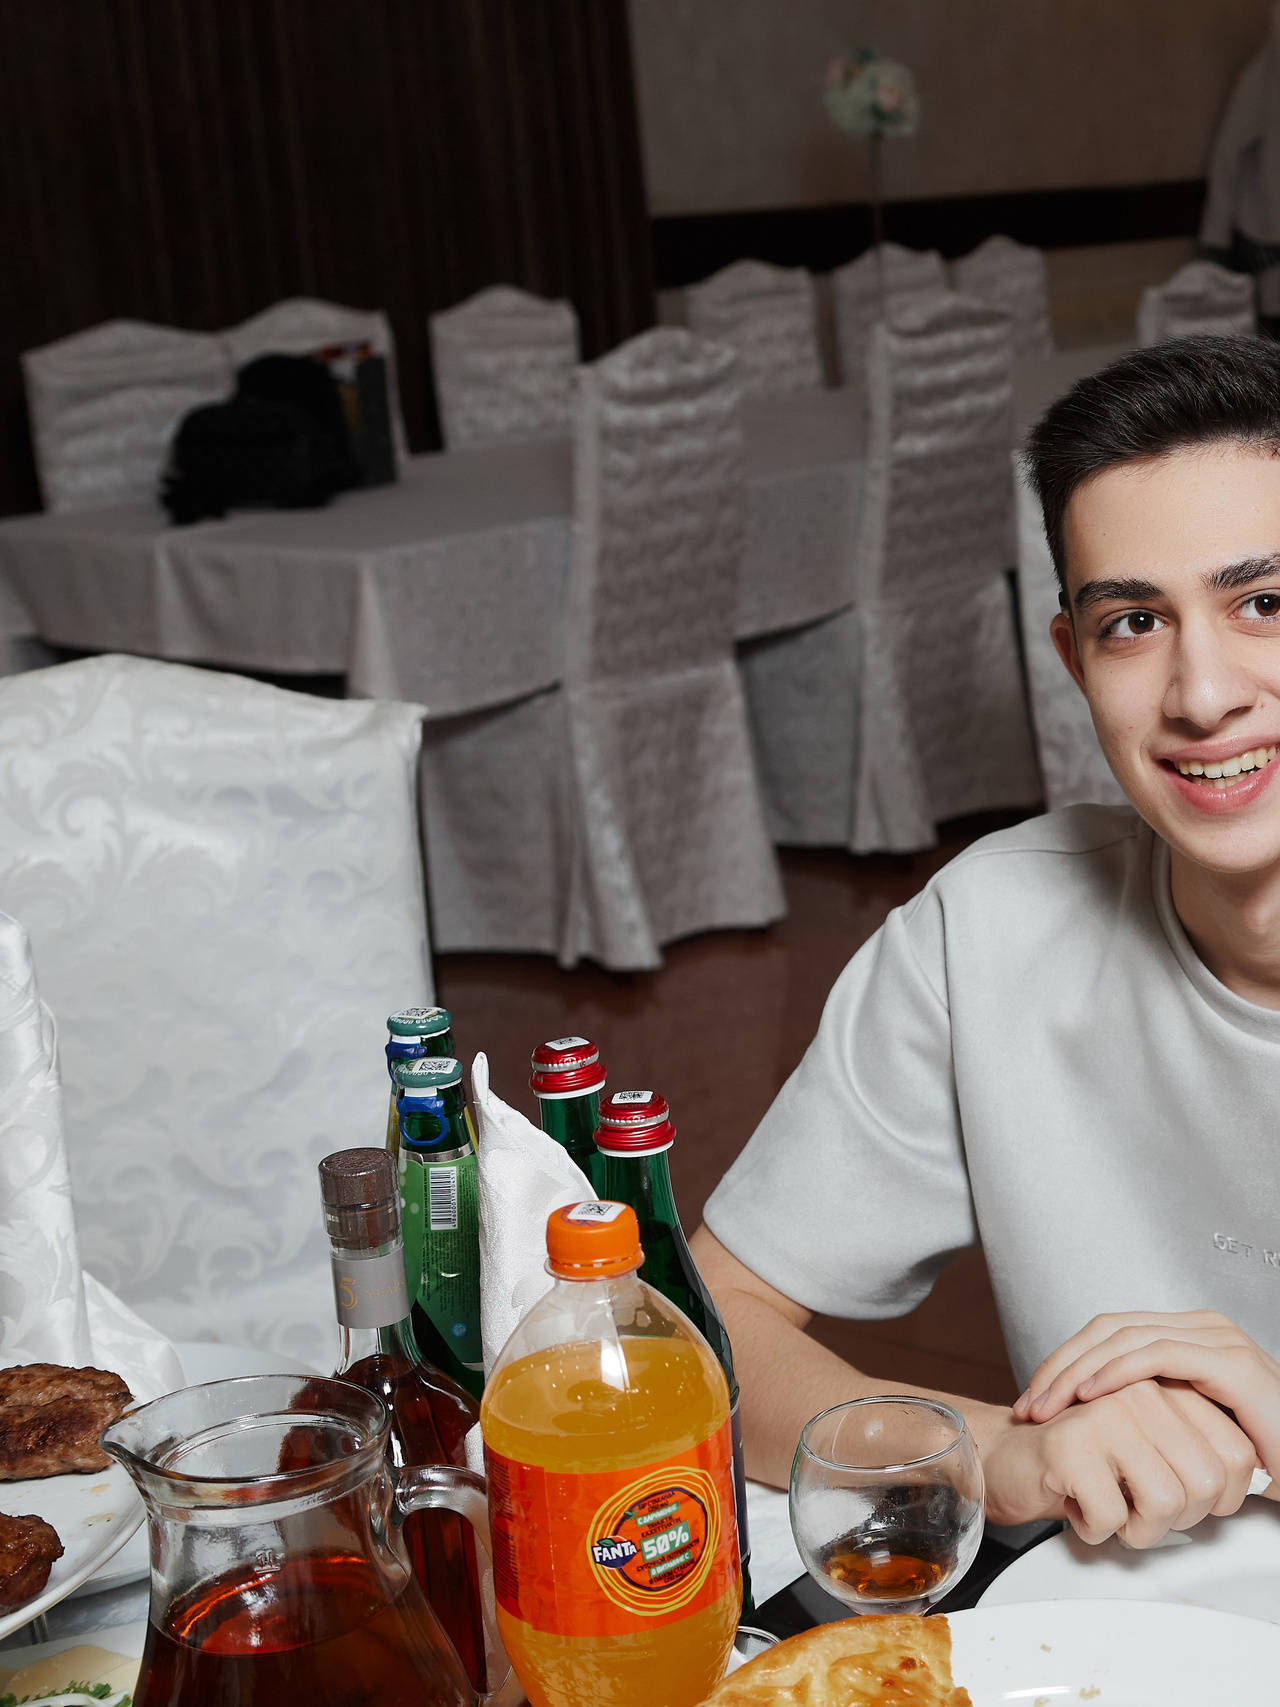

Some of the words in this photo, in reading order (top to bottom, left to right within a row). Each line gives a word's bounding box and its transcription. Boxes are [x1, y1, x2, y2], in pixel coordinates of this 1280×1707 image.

[1213, 1232, 1253, 1258] GET
[339, 1276, 358, 1311] 5
[592, 1541, 638, 1562] FANTA
[643, 1526, 690, 1559] 50%
